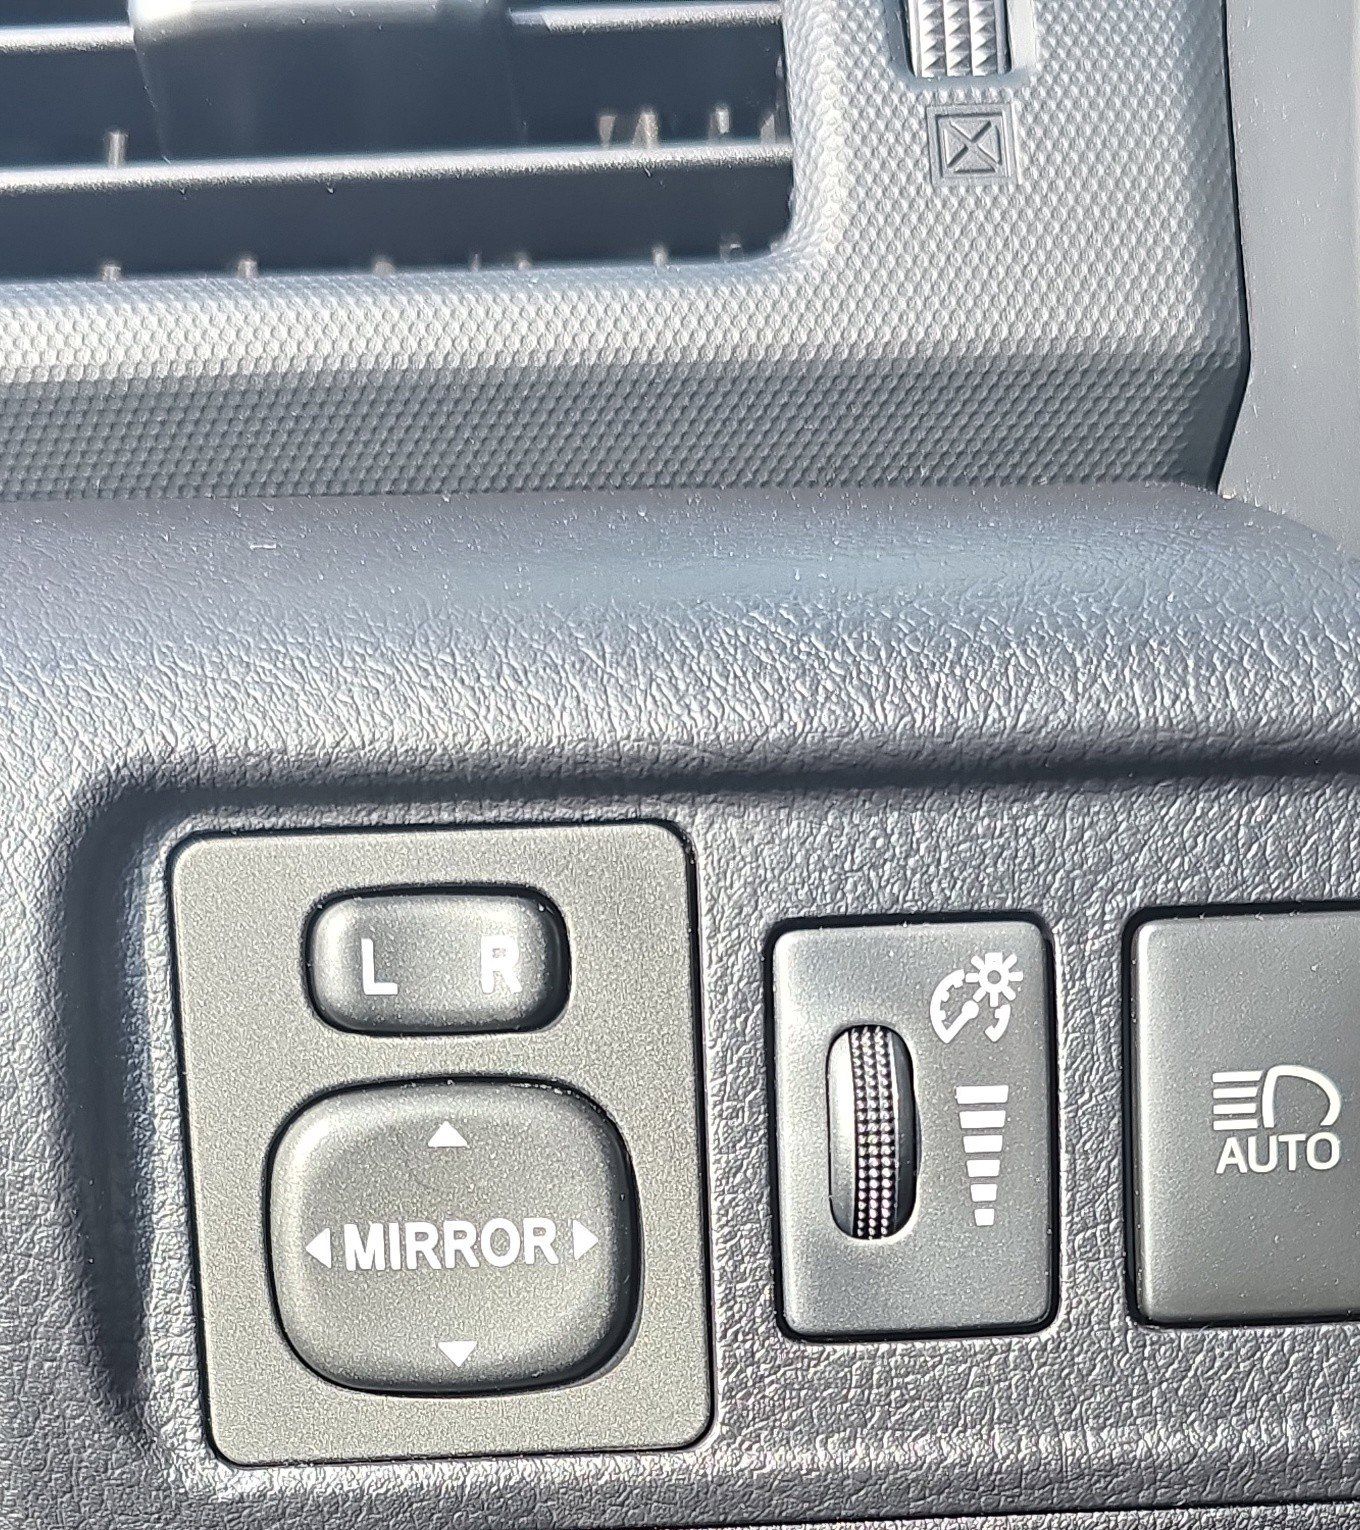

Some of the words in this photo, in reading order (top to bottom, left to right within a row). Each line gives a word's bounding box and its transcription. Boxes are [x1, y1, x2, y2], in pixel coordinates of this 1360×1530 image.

[360, 938, 398, 996] L
[479, 935, 522, 994] R
[1215, 1130, 1341, 1175] AUTO
[343, 1216, 560, 1272] MIRROR
